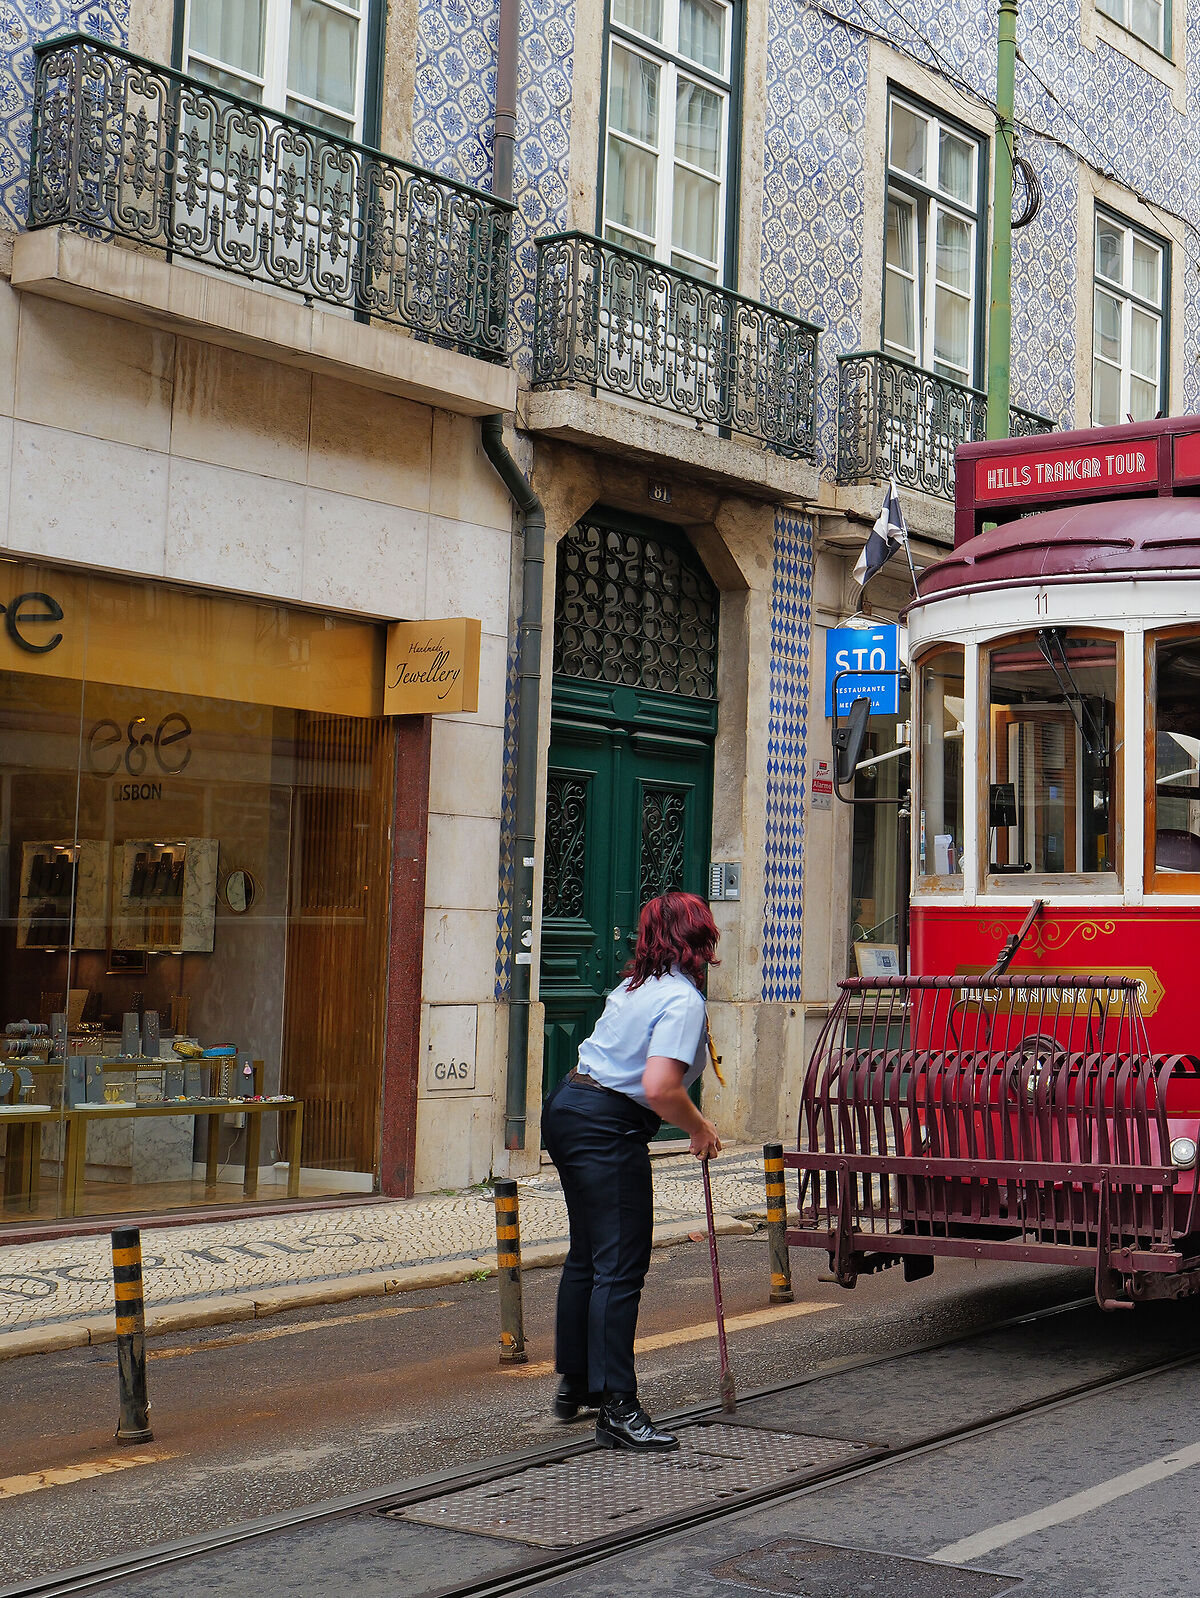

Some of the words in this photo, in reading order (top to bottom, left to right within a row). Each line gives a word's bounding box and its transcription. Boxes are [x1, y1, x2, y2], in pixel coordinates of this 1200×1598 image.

[987, 465, 1032, 489] HILLS
[1035, 457, 1102, 484] TRAMCAR
[1105, 452, 1146, 476] TOUR
[1034, 592, 1048, 615] 11
[387, 650, 461, 700] Jewellery
[112, 783, 162, 802] LISBON
[434, 1057, 468, 1080] GÁS
